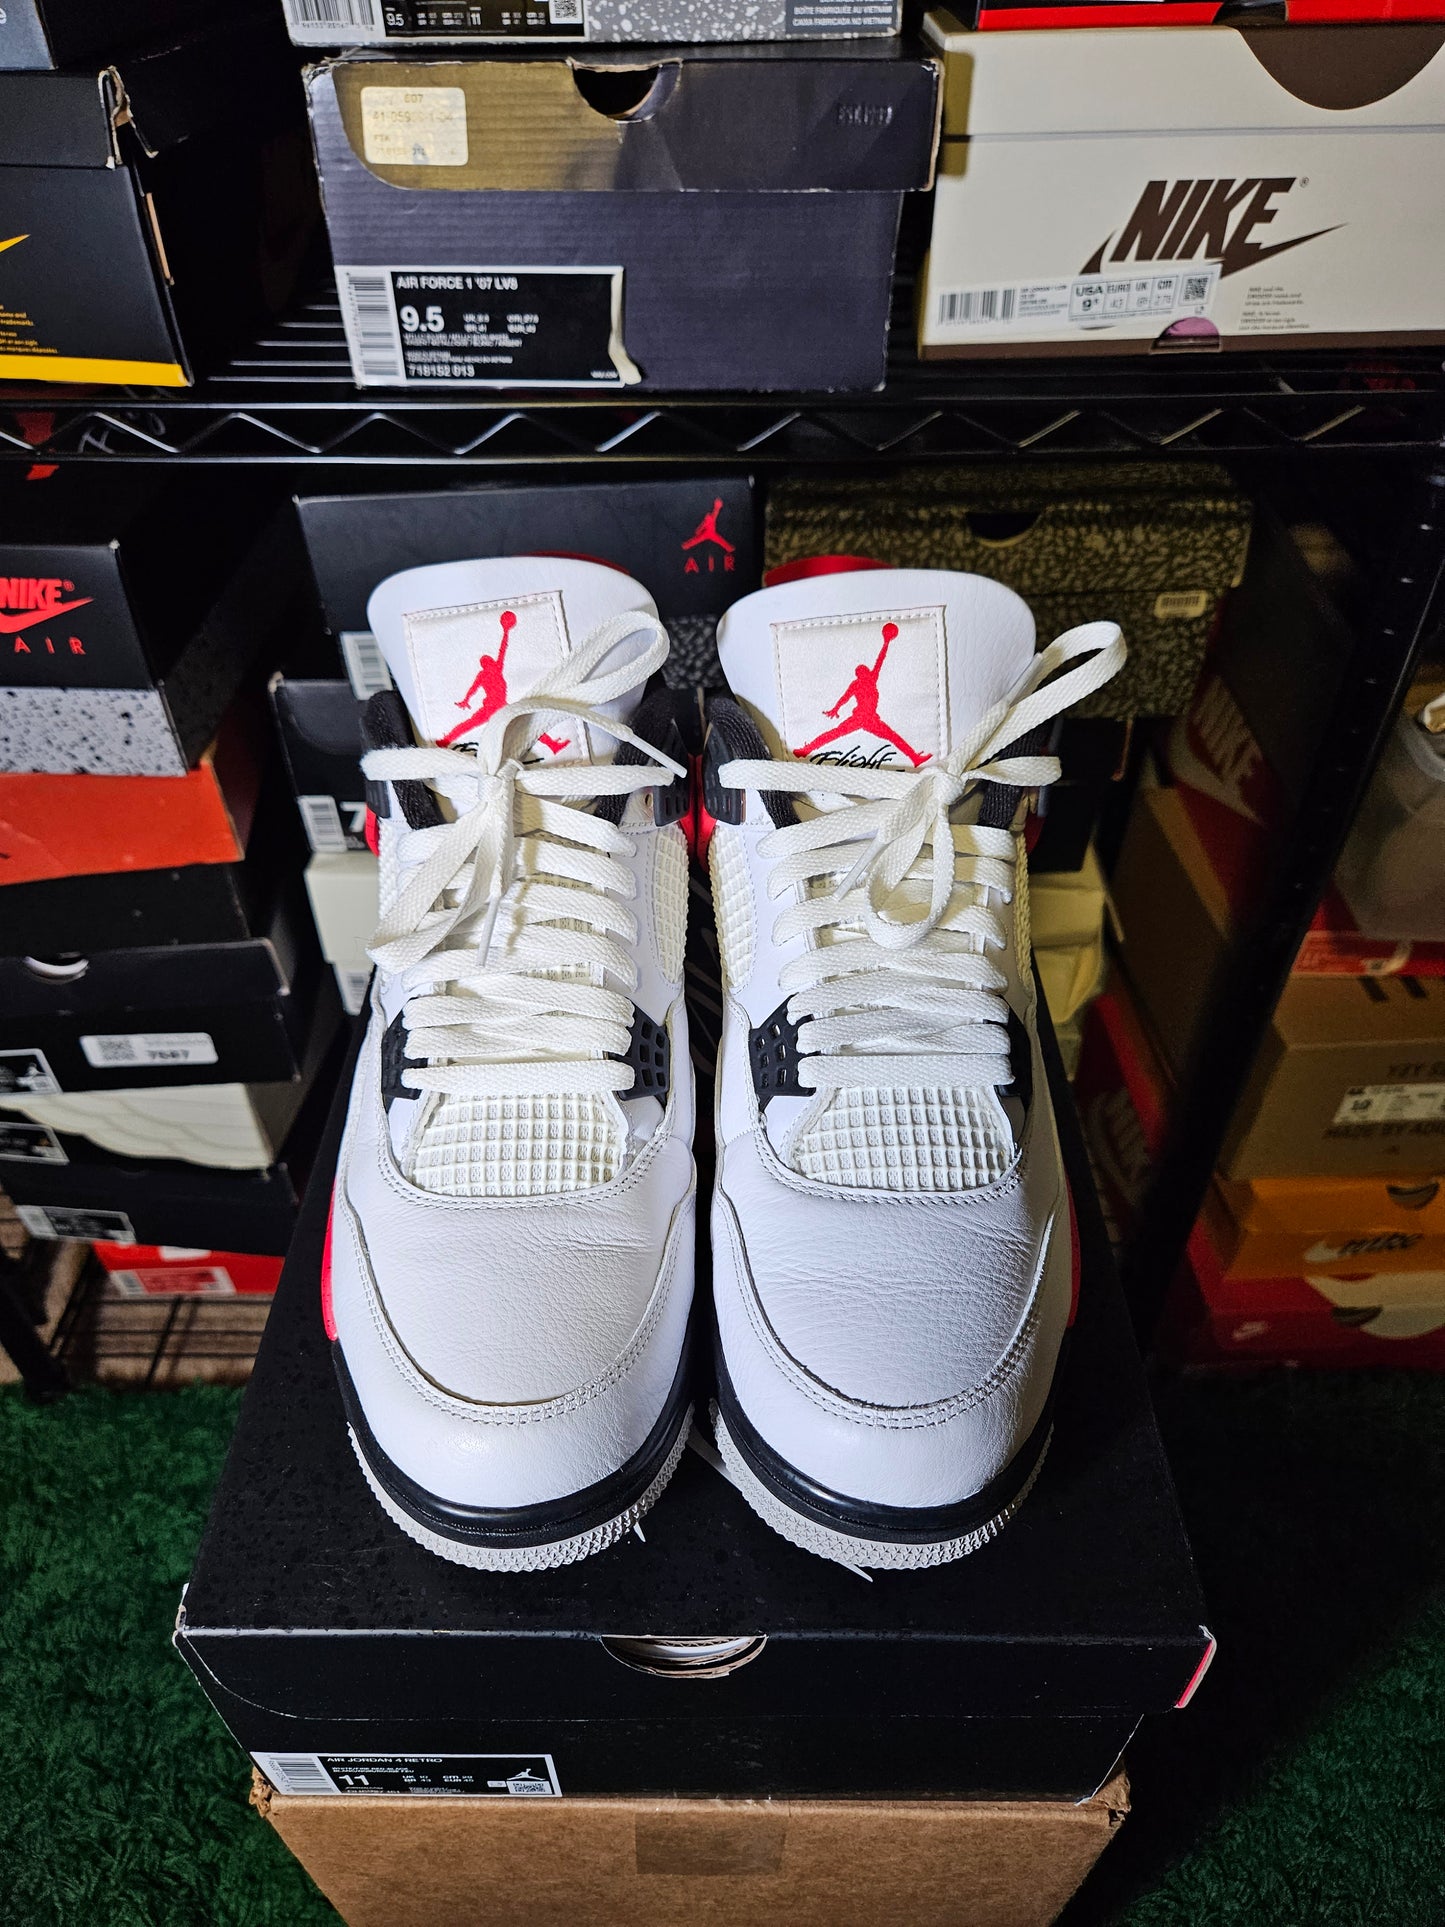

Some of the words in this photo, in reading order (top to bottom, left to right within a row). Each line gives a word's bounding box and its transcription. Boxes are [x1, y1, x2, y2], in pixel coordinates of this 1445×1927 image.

[1109, 177, 1297, 262] NIKE
[396, 275, 419, 290] AIR
[420, 276, 464, 290] FORCE
[465, 277, 473, 290] 1
[494, 277, 518, 291] LV8
[1075, 286, 1103, 297] USA
[400, 305, 445, 333] 9.5
[684, 555, 736, 574] AIR
[0, 577, 63, 610] NIKE
[14, 635, 87, 655] AIR
[338, 1774, 370, 1786] 11
